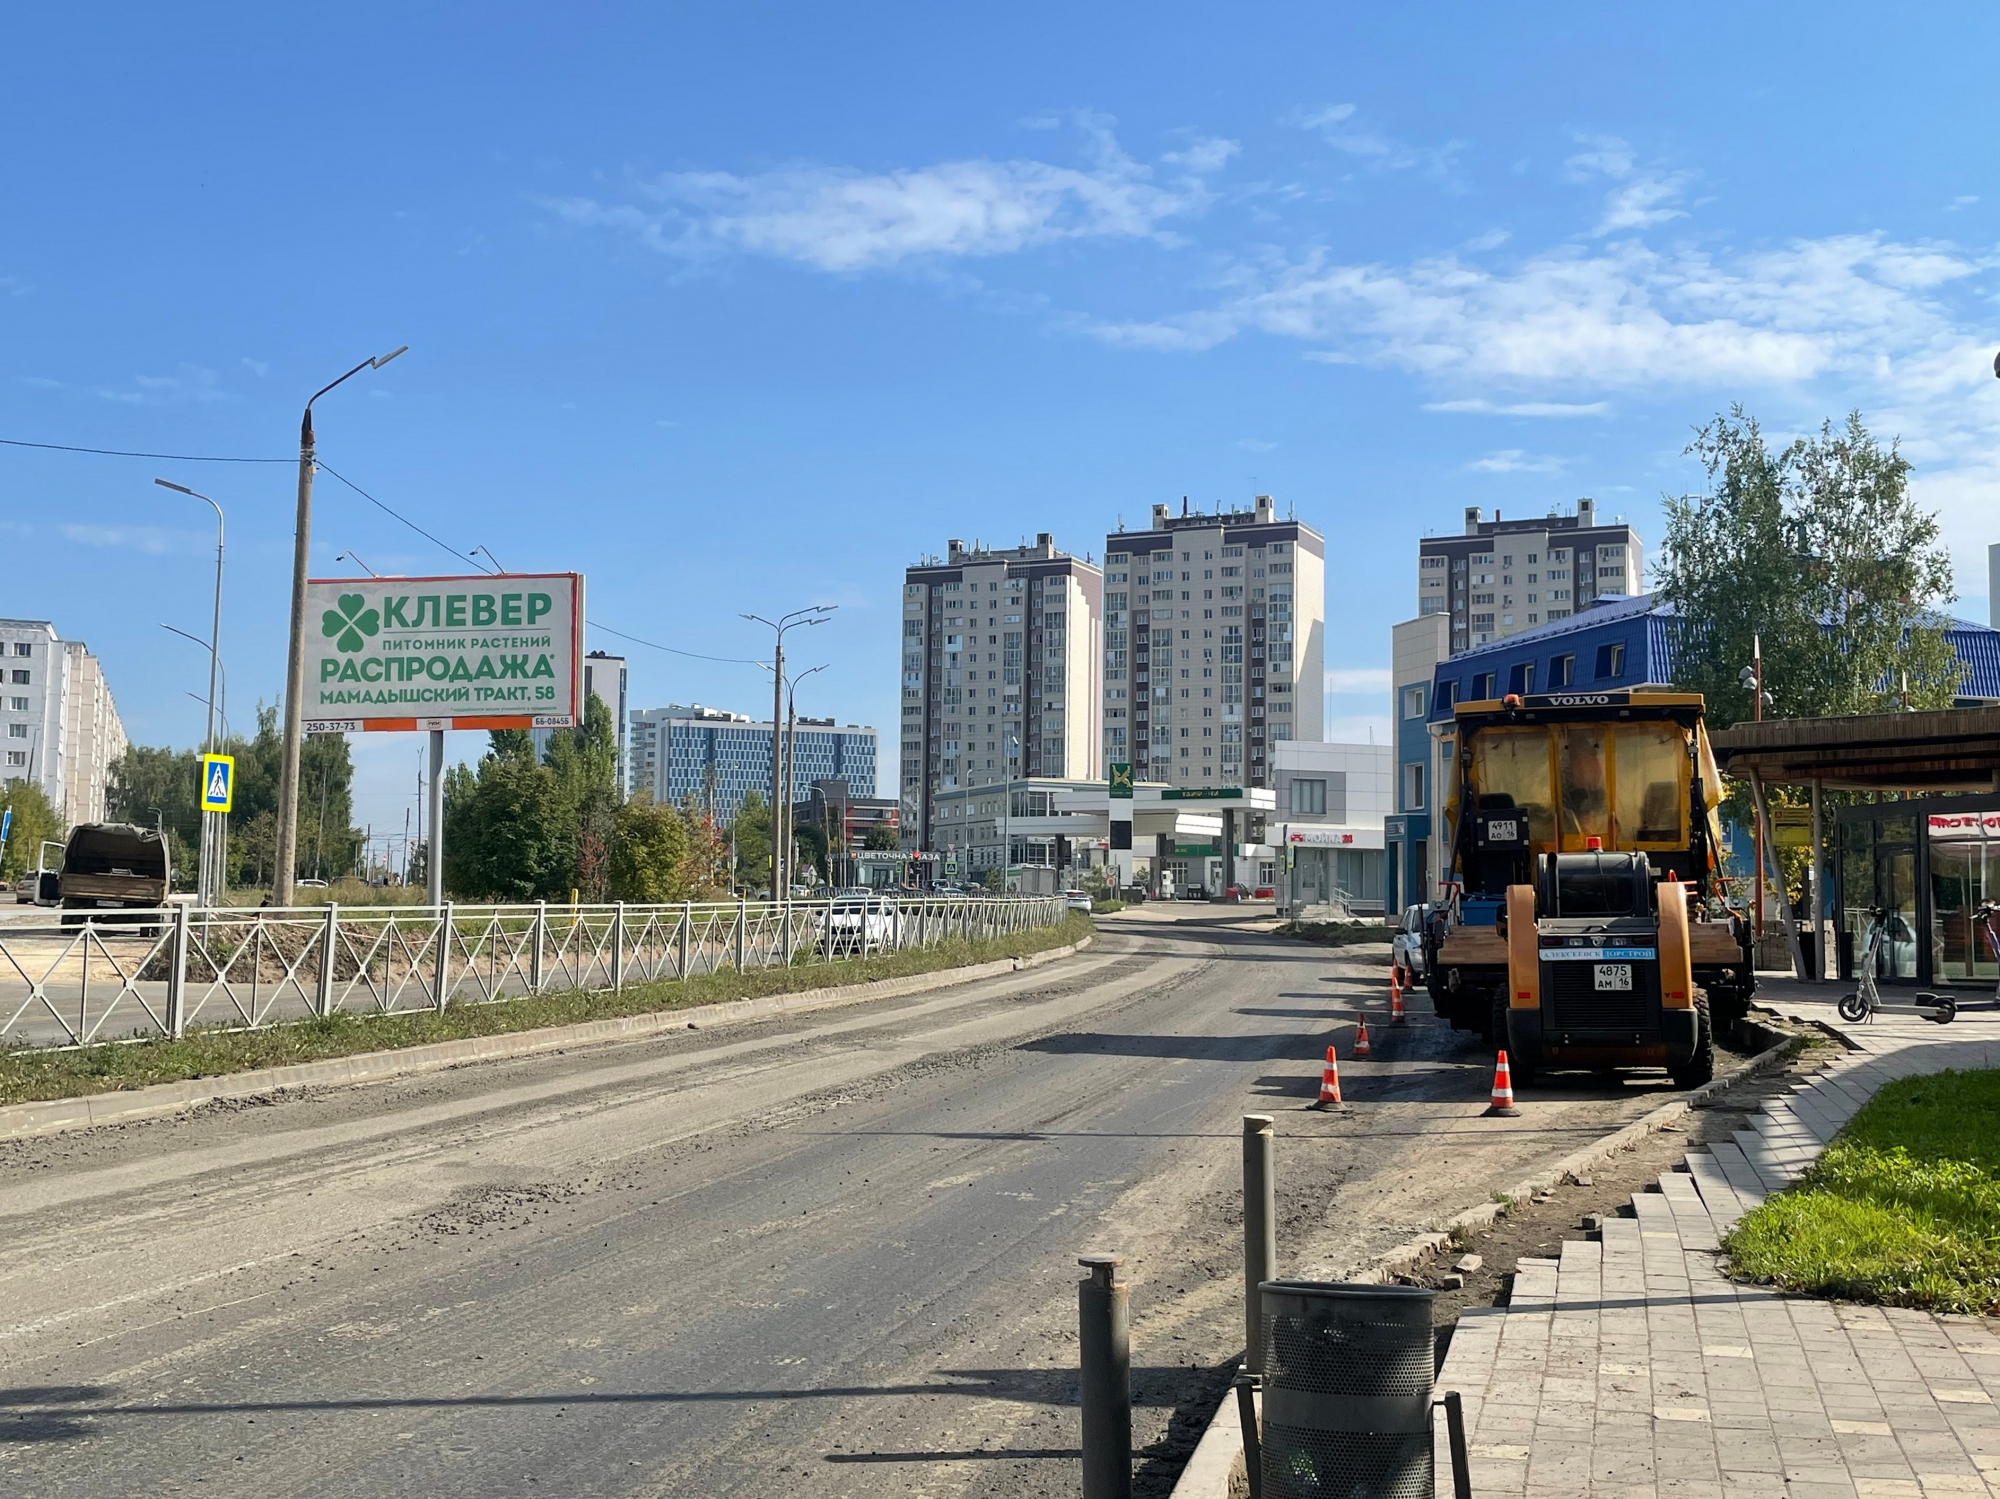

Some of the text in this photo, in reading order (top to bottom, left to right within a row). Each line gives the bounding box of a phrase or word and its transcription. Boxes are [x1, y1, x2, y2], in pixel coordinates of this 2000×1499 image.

[383, 593, 552, 628] КЛЕВЕР
[382, 635, 551, 651] ПИТОМНИК РАСТЕНИЙ
[320, 685, 555, 705] МАМАДЫШСКИЙ ТРАКТ, 58
[1547, 695, 1609, 706] VOLVO
[306, 722, 356, 731] 250-37-73
[1492, 821, 1513, 830] 4911
[1544, 949, 1653, 959] АЛЕКСЕЕВСК ДОРСТРОЙ
[1599, 965, 1627, 976] 4875
[1597, 977, 1630, 989] АМ 16
